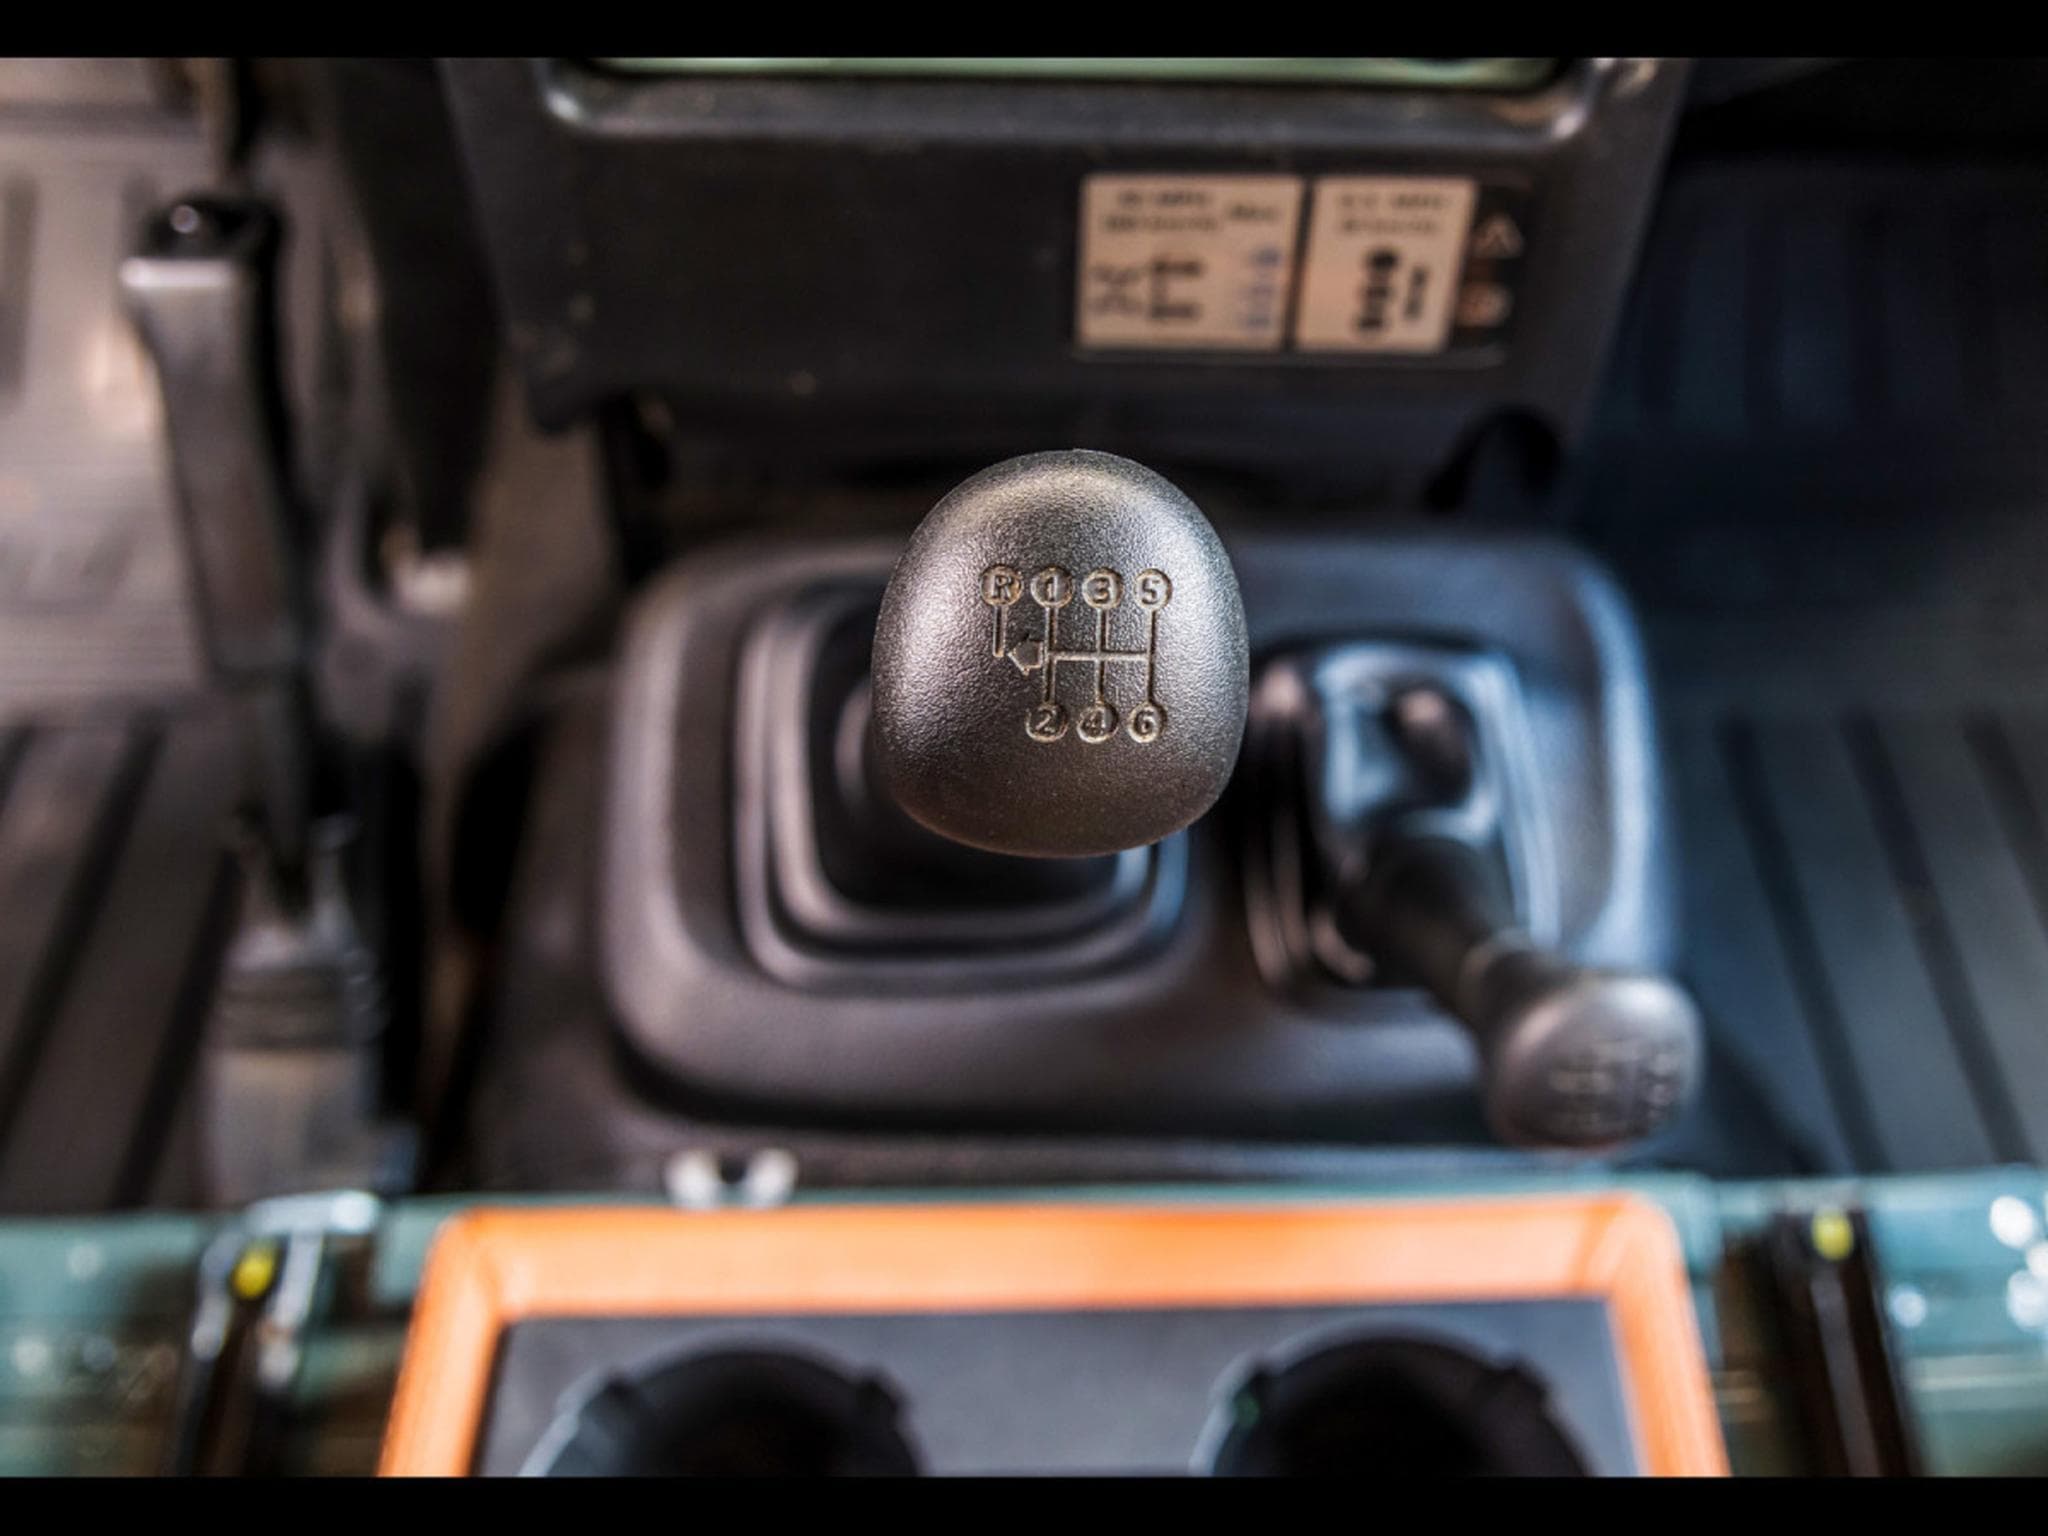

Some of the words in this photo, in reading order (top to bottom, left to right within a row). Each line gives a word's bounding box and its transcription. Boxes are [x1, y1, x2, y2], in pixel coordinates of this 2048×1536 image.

[990, 574, 1013, 601] R
[1044, 575, 1060, 601] 1
[1091, 577, 1113, 604] 3
[1140, 578, 1160, 605] 5
[1034, 708, 1058, 734] 2
[1084, 707, 1108, 732] 4
[1132, 708, 1156, 734] 6
